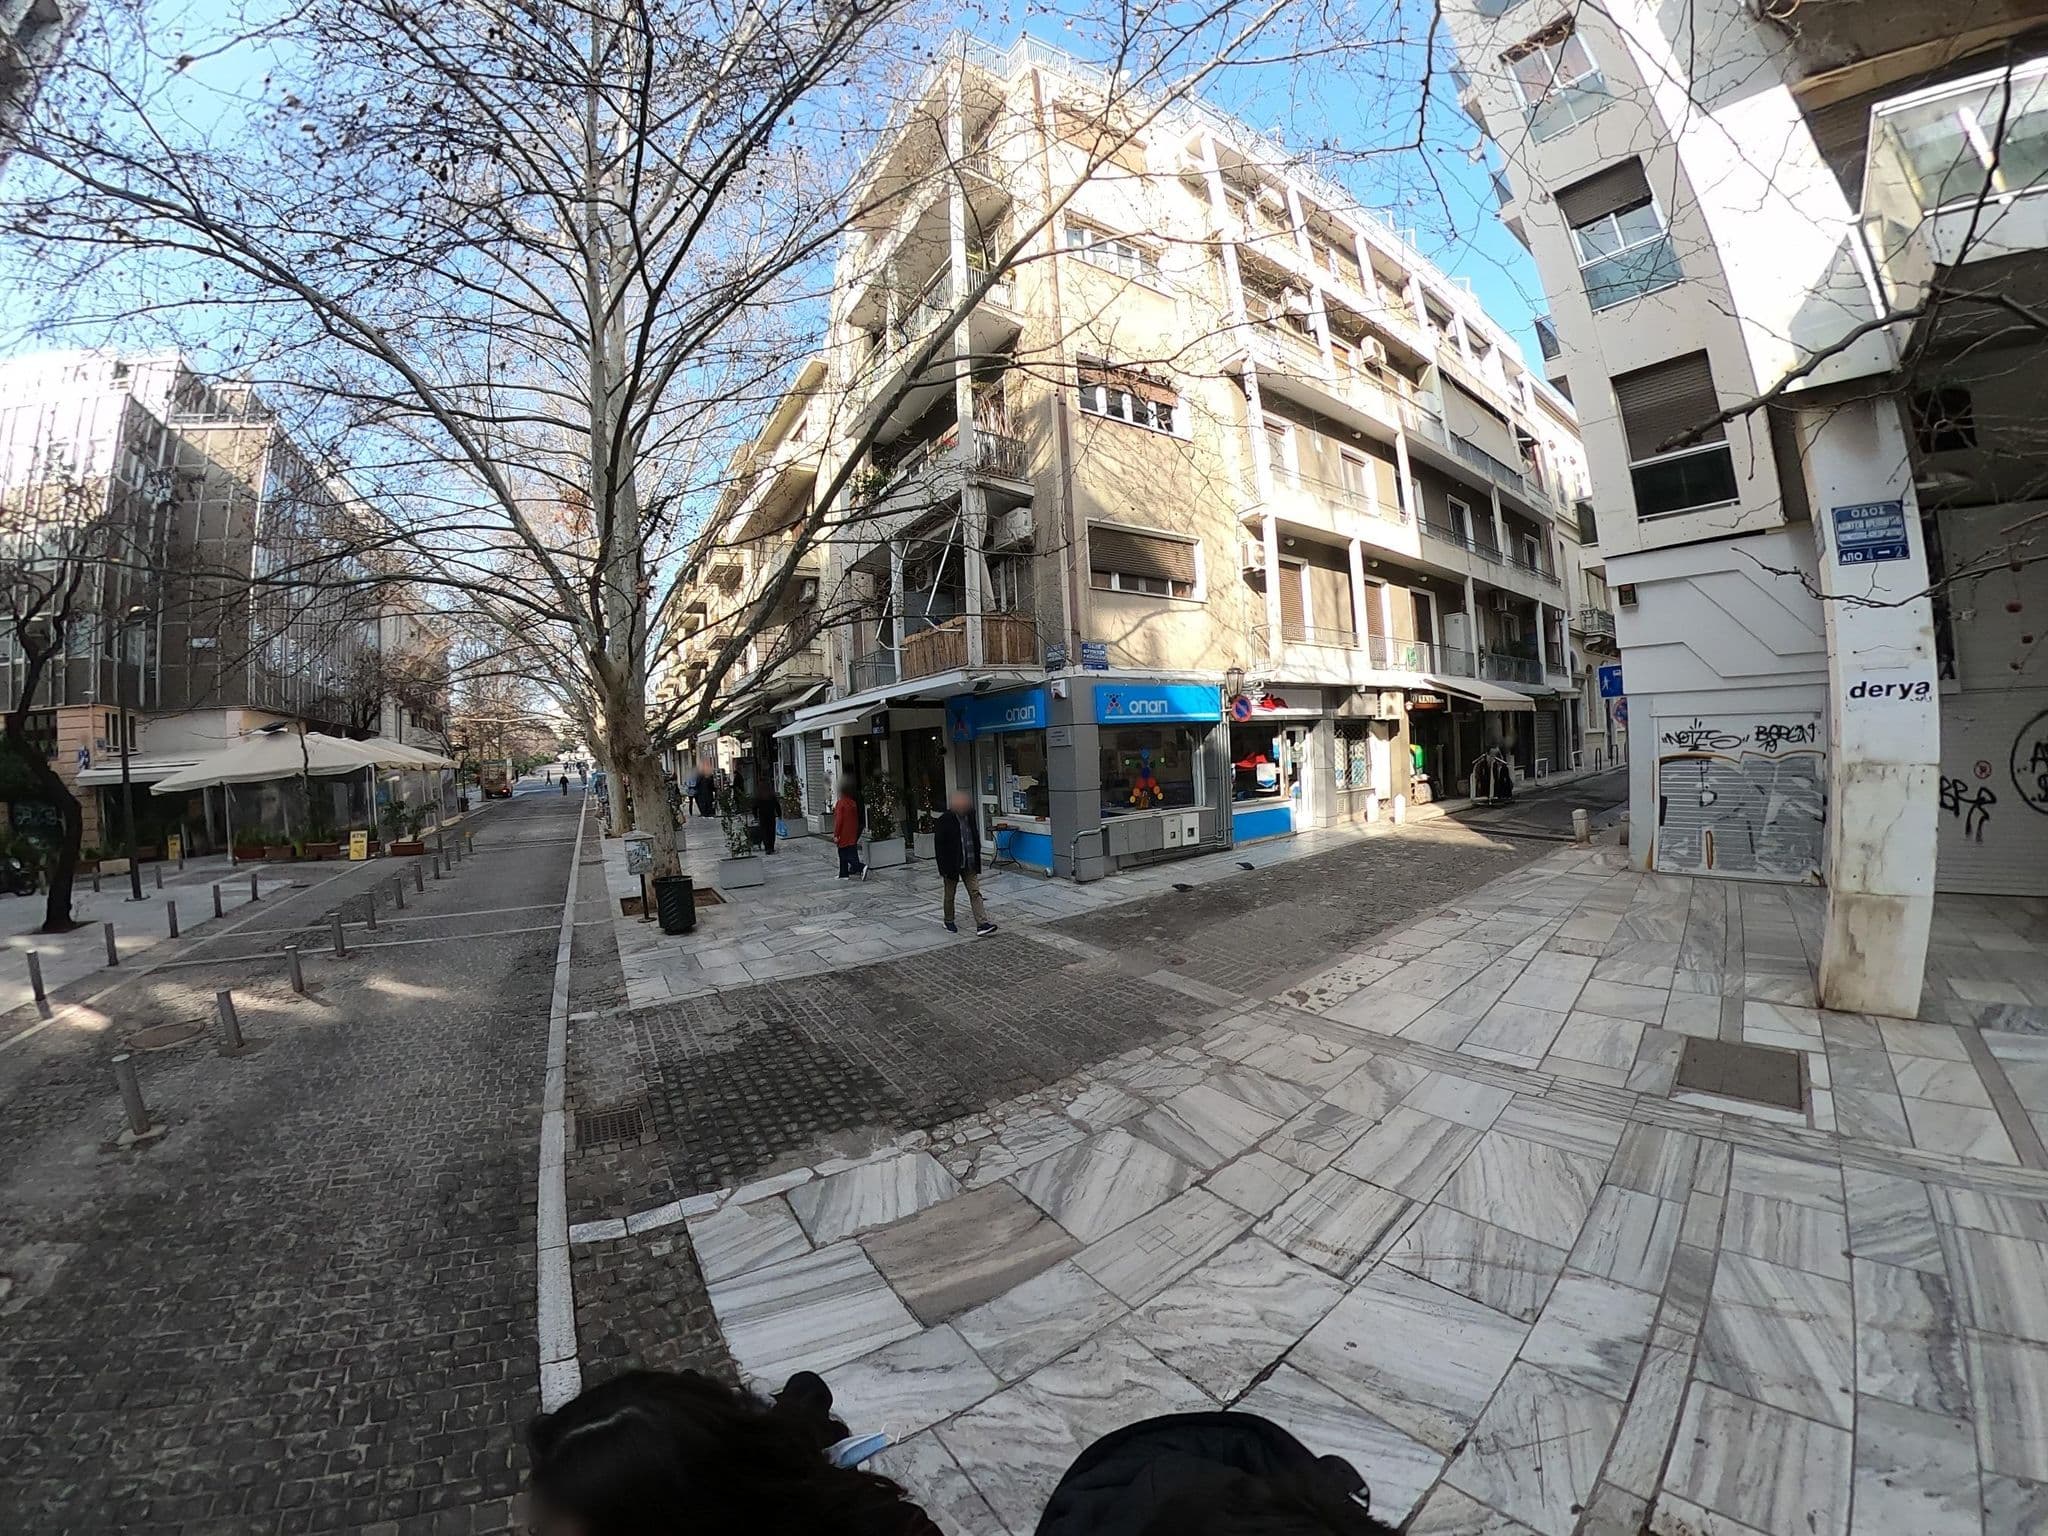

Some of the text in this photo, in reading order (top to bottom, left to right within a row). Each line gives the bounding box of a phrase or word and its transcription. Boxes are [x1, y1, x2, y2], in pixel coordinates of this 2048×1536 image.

[1851, 505, 1886, 518] ΟΔΟΣ
[1841, 551, 1863, 562] ΑΠΟ
[1849, 681, 1930, 700] derya
